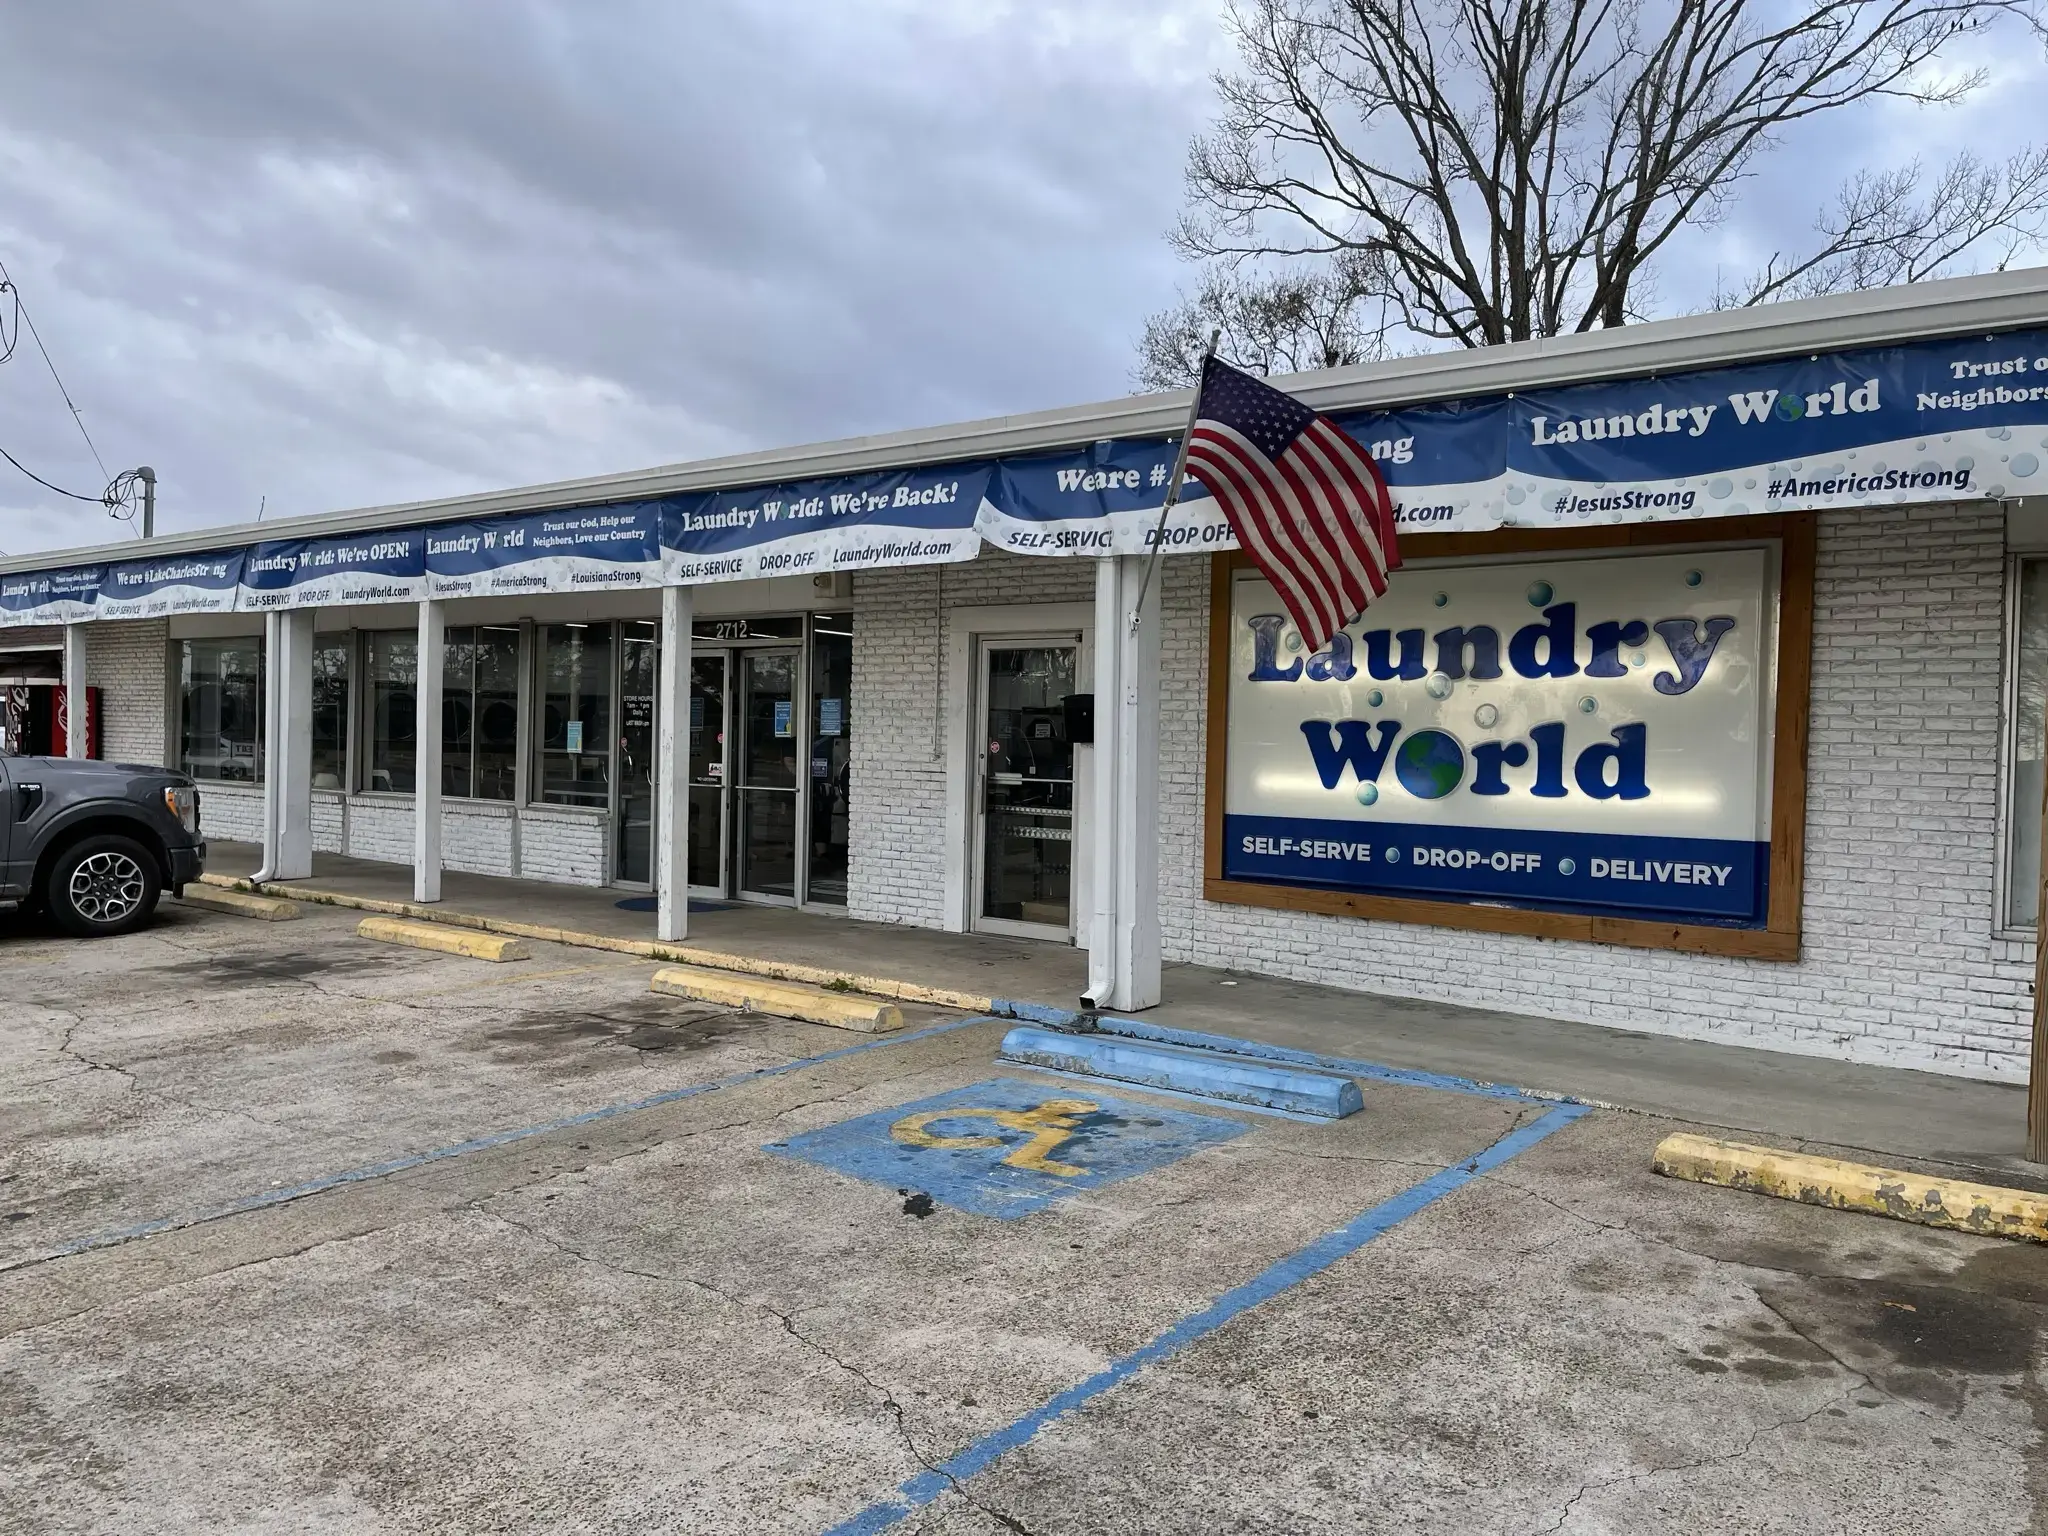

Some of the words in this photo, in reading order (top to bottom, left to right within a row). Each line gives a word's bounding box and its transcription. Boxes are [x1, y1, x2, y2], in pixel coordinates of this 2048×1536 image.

[1950, 356, 2028, 379] Trust
[1531, 399, 1717, 446] Laundry
[1554, 491, 1696, 515] #JesusStrong
[1767, 466, 1971, 500] #AmericaStrong
[682, 508, 759, 532] Laundry
[831, 489, 889, 514] We're
[892, 481, 959, 508] Back!
[543, 520, 565, 532] Trust
[565, 520, 579, 531] our
[580, 517, 598, 530] God,
[600, 516, 619, 528] Help
[620, 515, 636, 525] our
[427, 534, 480, 555] Laundry
[483, 529, 525, 549] Wrld
[533, 535, 574, 548] Neighbors,
[575, 532, 593, 544] Love
[594, 532, 609, 543] our
[610, 529, 646, 542] Country
[1144, 527, 1198, 546] DROP
[251, 555, 298, 573] Lundry
[299, 549, 335, 567] Wrld:
[370, 541, 410, 559] OPEN!
[680, 558, 742, 579] SELF-SERVICE
[760, 553, 792, 571] DROP
[793, 552, 814, 567] OFF
[833, 541, 951, 564] LaundryWorld.com
[116, 572, 128, 586] We
[129, 574, 143, 584] are
[144, 564, 228, 583] #LakeCharlesStrng
[435, 580, 472, 593] #JesusStrong
[491, 575, 547, 589] #AmericaStrong
[571, 570, 642, 584] #LouisianaStrong
[30, 580, 50, 594] Wrld
[316, 590, 330, 601] OFF
[342, 585, 410, 601] LaundryWorld.com
[716, 622, 748, 639] 2712
[1246, 602, 1736, 695] Laundry
[1241, 835, 1372, 863] SELF-SERVE
[1412, 845, 1542, 874] DROP-OFF
[1590, 857, 1733, 886] DELIVERY
